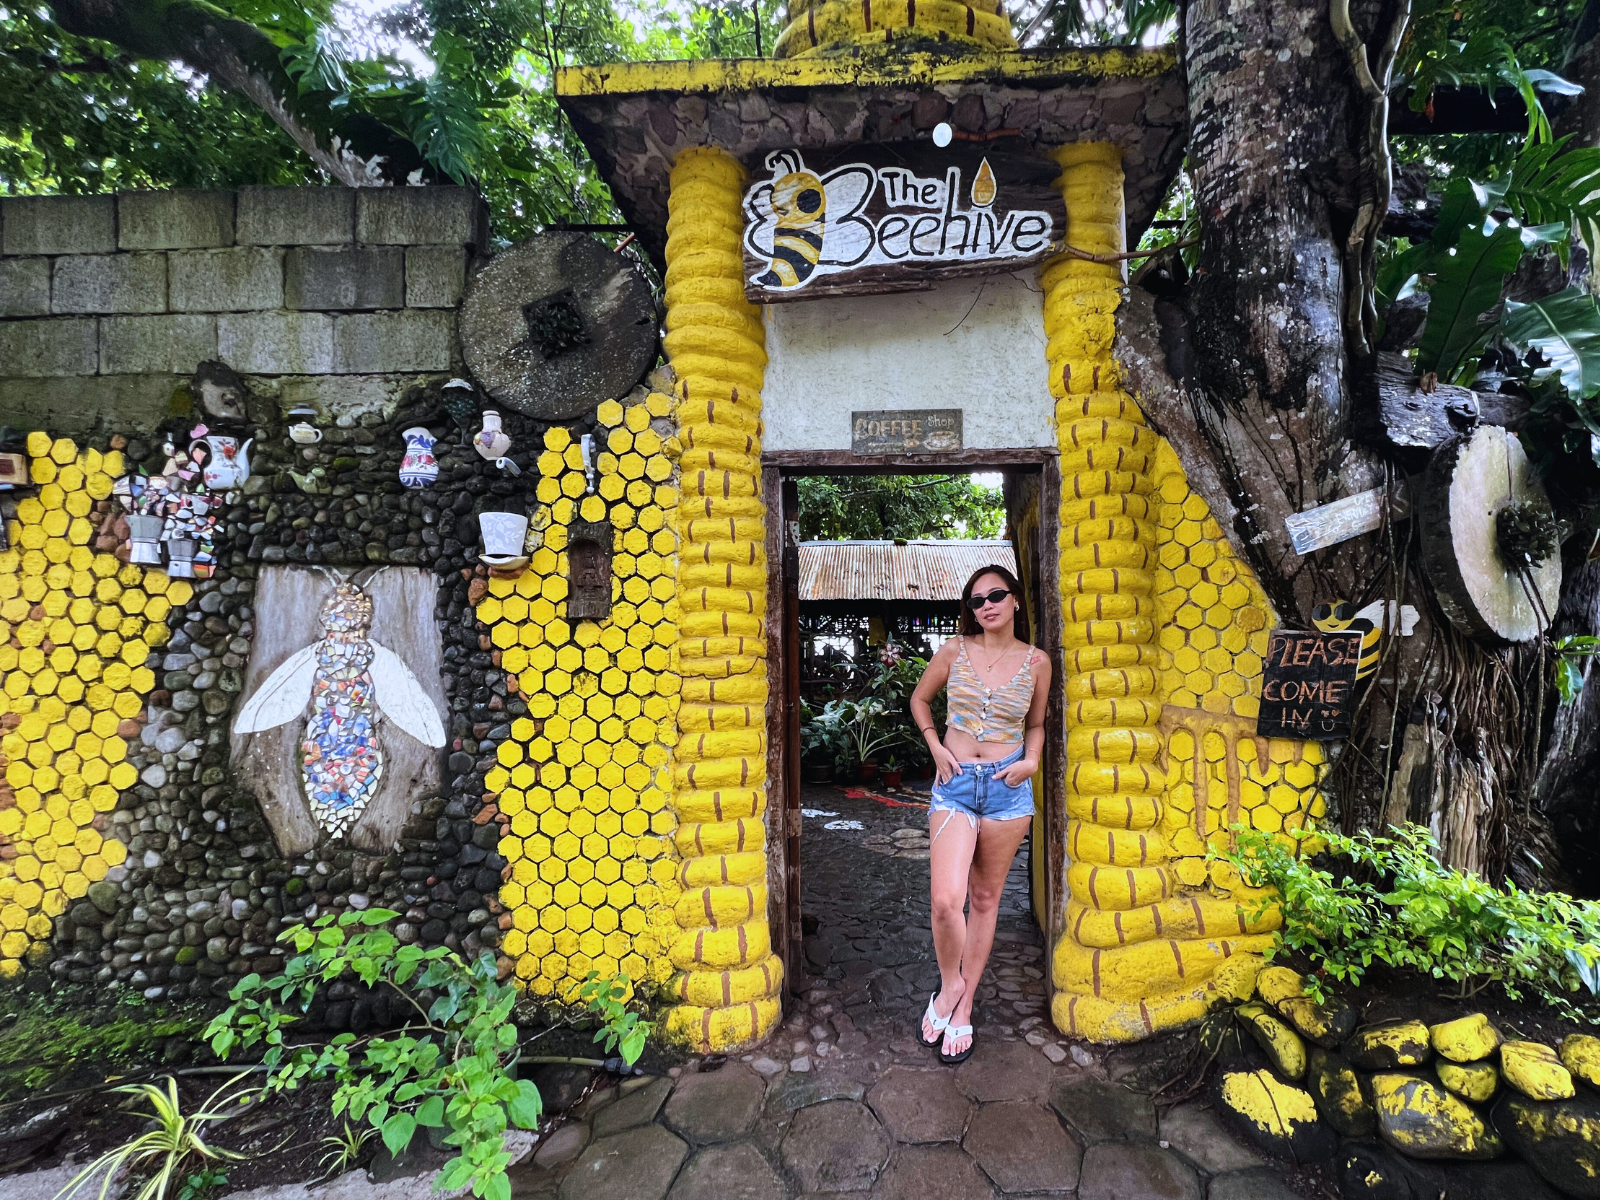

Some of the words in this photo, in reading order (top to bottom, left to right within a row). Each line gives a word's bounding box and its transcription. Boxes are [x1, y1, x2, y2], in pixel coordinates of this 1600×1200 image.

[880, 171, 938, 205] The
[819, 162, 1048, 266] Beehive
[855, 418, 922, 439] COFFEE
[927, 414, 955, 429] Shop
[1266, 637, 1361, 668] PLEASE
[1263, 680, 1348, 704] COME
[1280, 707, 1314, 729] IN
